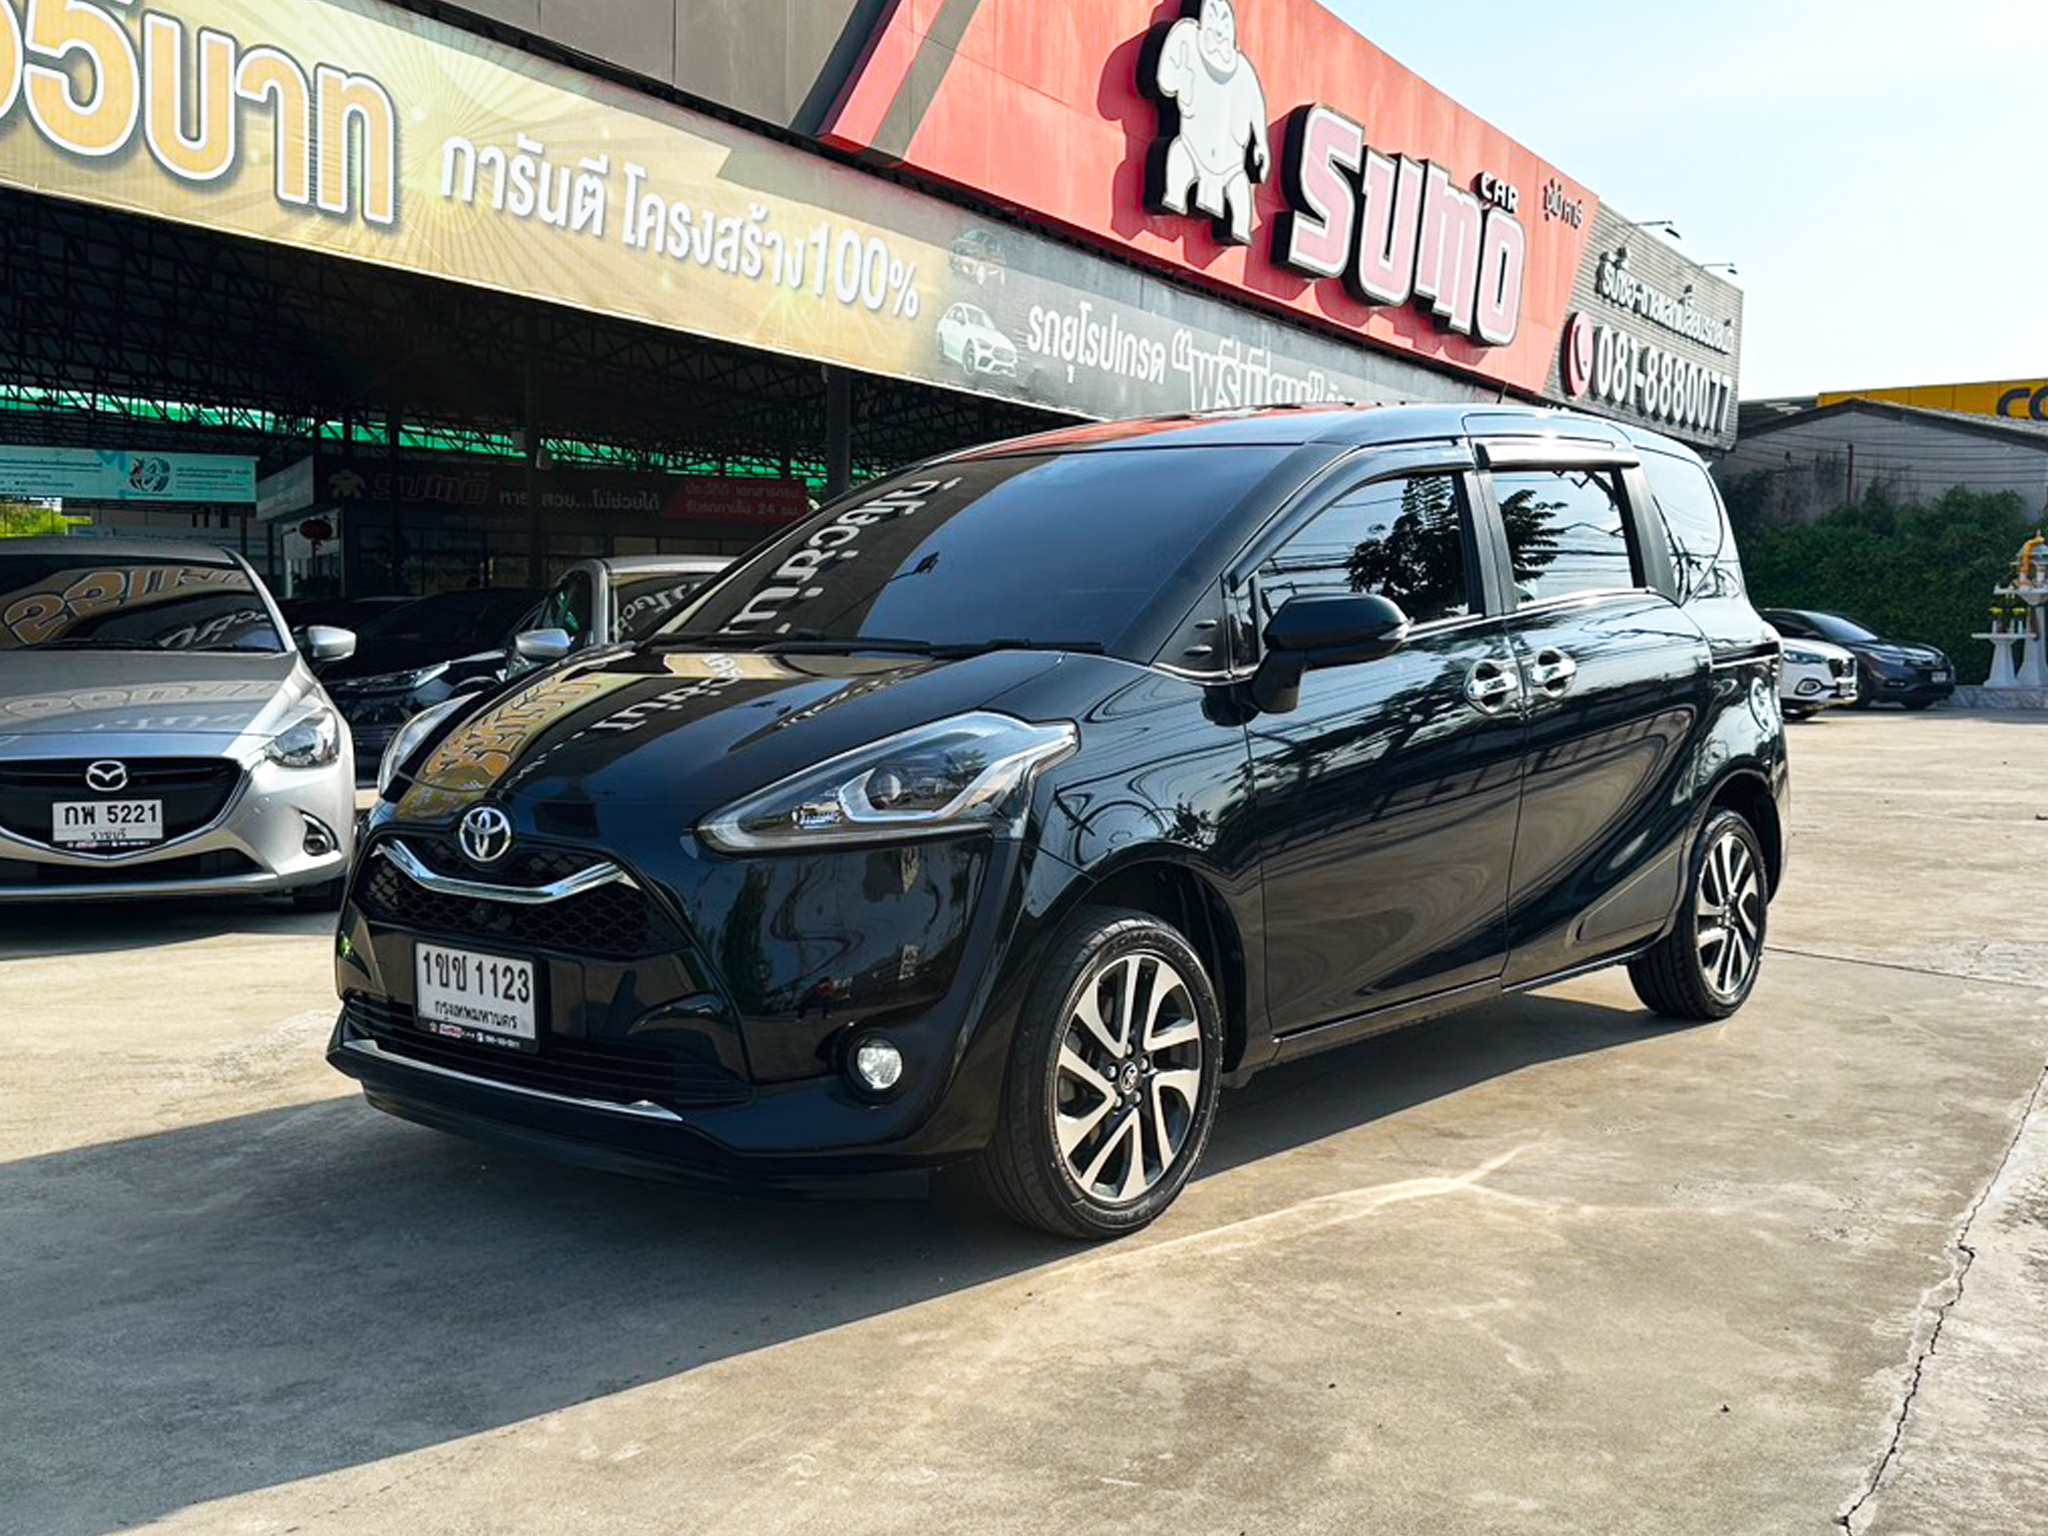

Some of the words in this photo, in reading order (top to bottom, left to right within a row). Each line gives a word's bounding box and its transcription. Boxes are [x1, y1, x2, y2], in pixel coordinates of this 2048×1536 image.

[1479, 171, 1520, 213] CAR
[441, 131, 609, 237] การันตี
[623, 162, 919, 318] โครงสร้าง100%
[1027, 301, 1166, 384] รถยุโรปเกรด
[1597, 324, 1733, 432] 081-8880077
[65, 805, 96, 825] กพ
[106, 803, 157, 824] 5221
[475, 959, 531, 1004] 1123
[435, 1000, 518, 1030] กรุงเทพมหานคร
